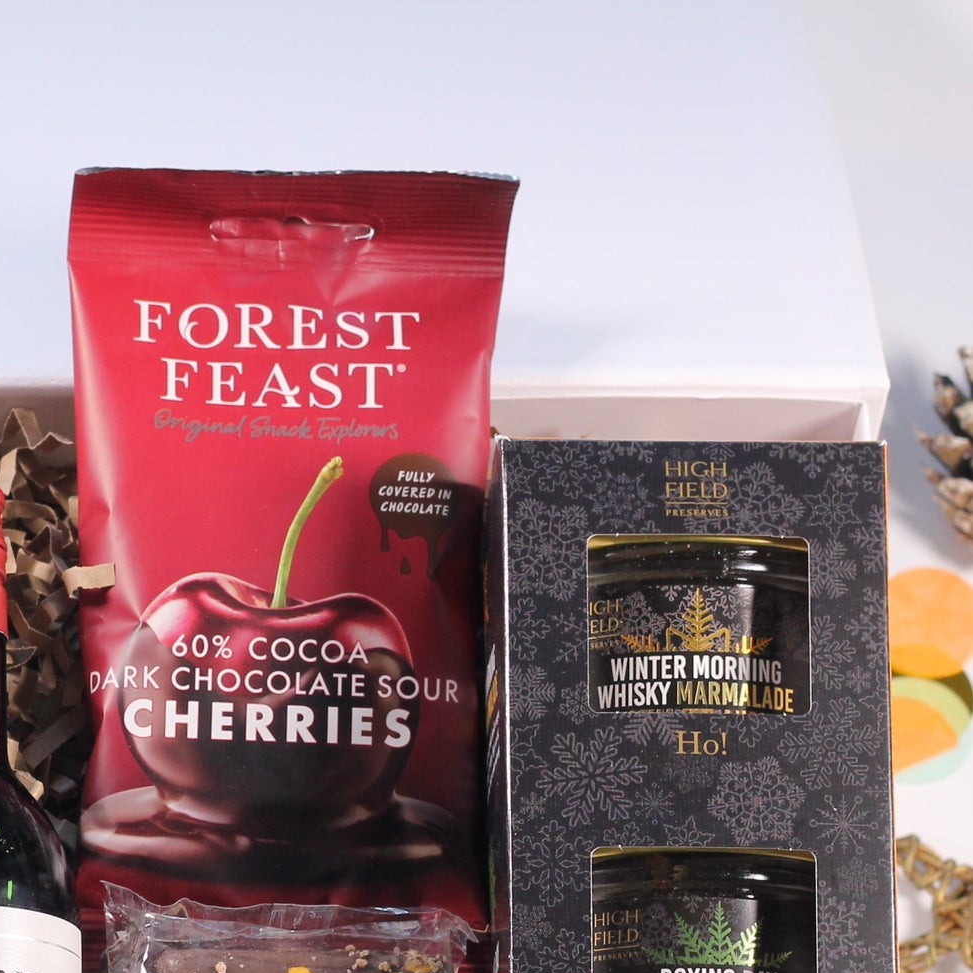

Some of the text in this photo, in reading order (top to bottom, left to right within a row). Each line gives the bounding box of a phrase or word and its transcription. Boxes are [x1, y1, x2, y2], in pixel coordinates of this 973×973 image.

[133, 299, 420, 351] FOREST
[154, 409, 399, 444] Original Snack Explorers
[397, 470, 435, 483] FULLY
[664, 461, 727, 477] HIGH
[378, 485, 452, 500] COVERED IN
[665, 482, 727, 498] FIELD
[380, 501, 449, 516] CHOCOLATE
[665, 508, 728, 517] PRESERVES
[589, 598, 619, 616] IGH
[590, 616, 619, 634] ELD
[172, 633, 369, 664] 60% COCOA
[590, 640, 620, 650] SERVES
[610, 655, 782, 684] WINTER MORNING
[90, 665, 458, 702] DARK CHOCOLATE SOUR
[598, 681, 794, 713] WHISKY MARMALADE
[124, 699, 413, 748] CHERRIES
[676, 731, 727, 756] Ho!
[594, 908, 639, 928] HIGH
[594, 928, 639, 946] FIELD
